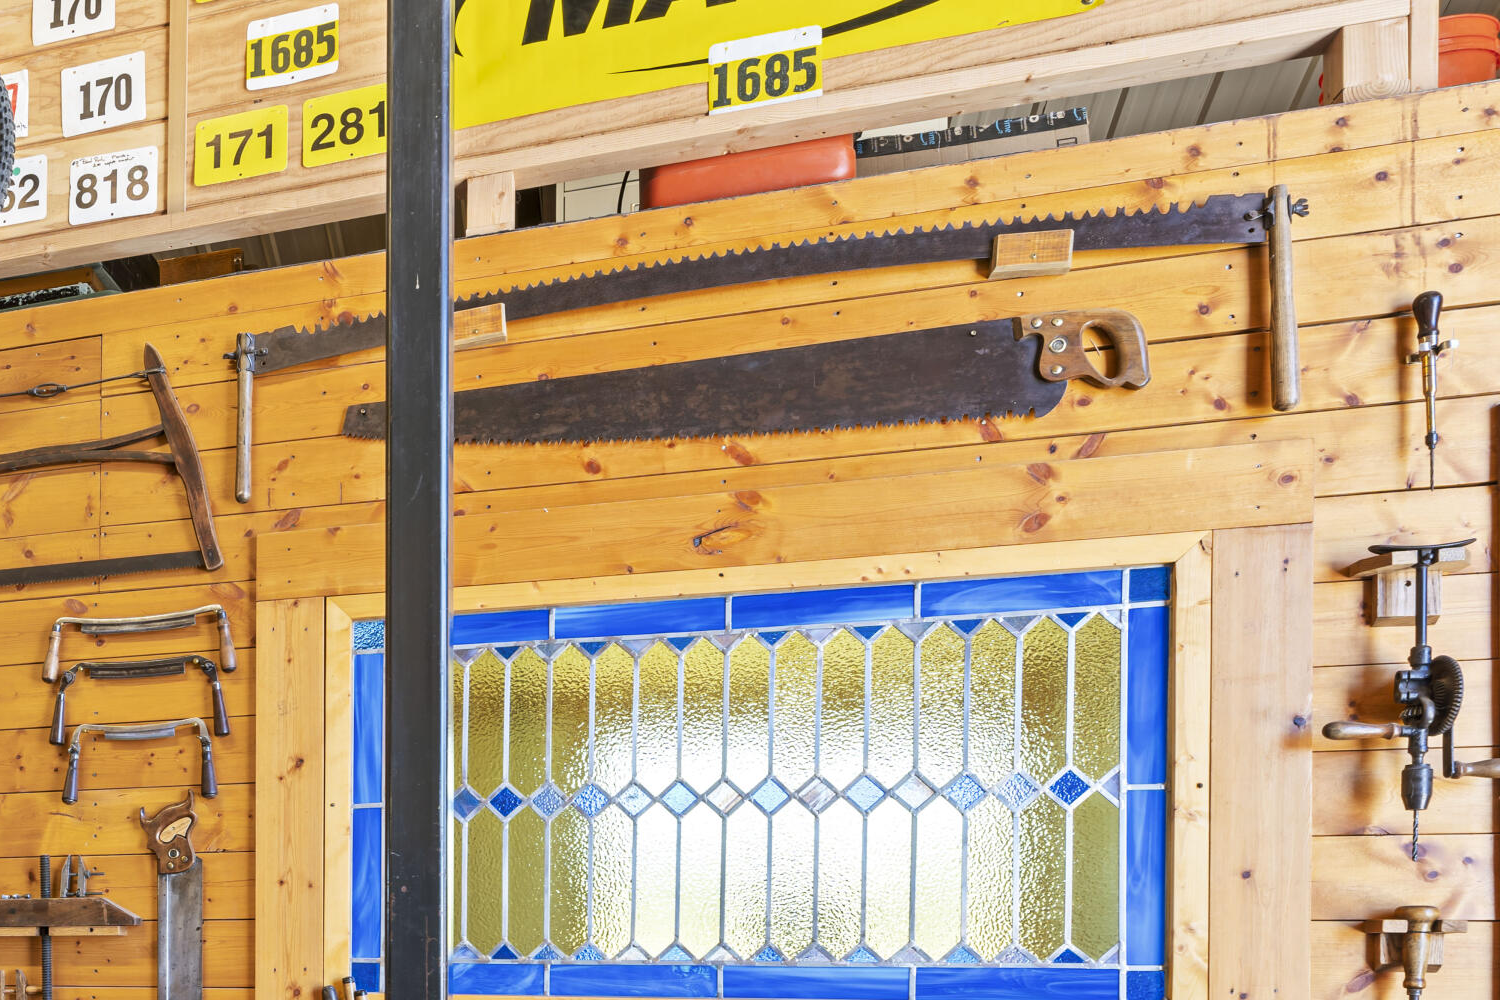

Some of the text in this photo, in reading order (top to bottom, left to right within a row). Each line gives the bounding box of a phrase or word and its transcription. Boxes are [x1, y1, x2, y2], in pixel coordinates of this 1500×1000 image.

[250, 22, 336, 77] 1685
[79, 73, 132, 121] 170
[712, 47, 817, 108] 1685
[206, 124, 273, 169] 171
[310, 101, 385, 151] 281
[75, 165, 150, 210] 818
